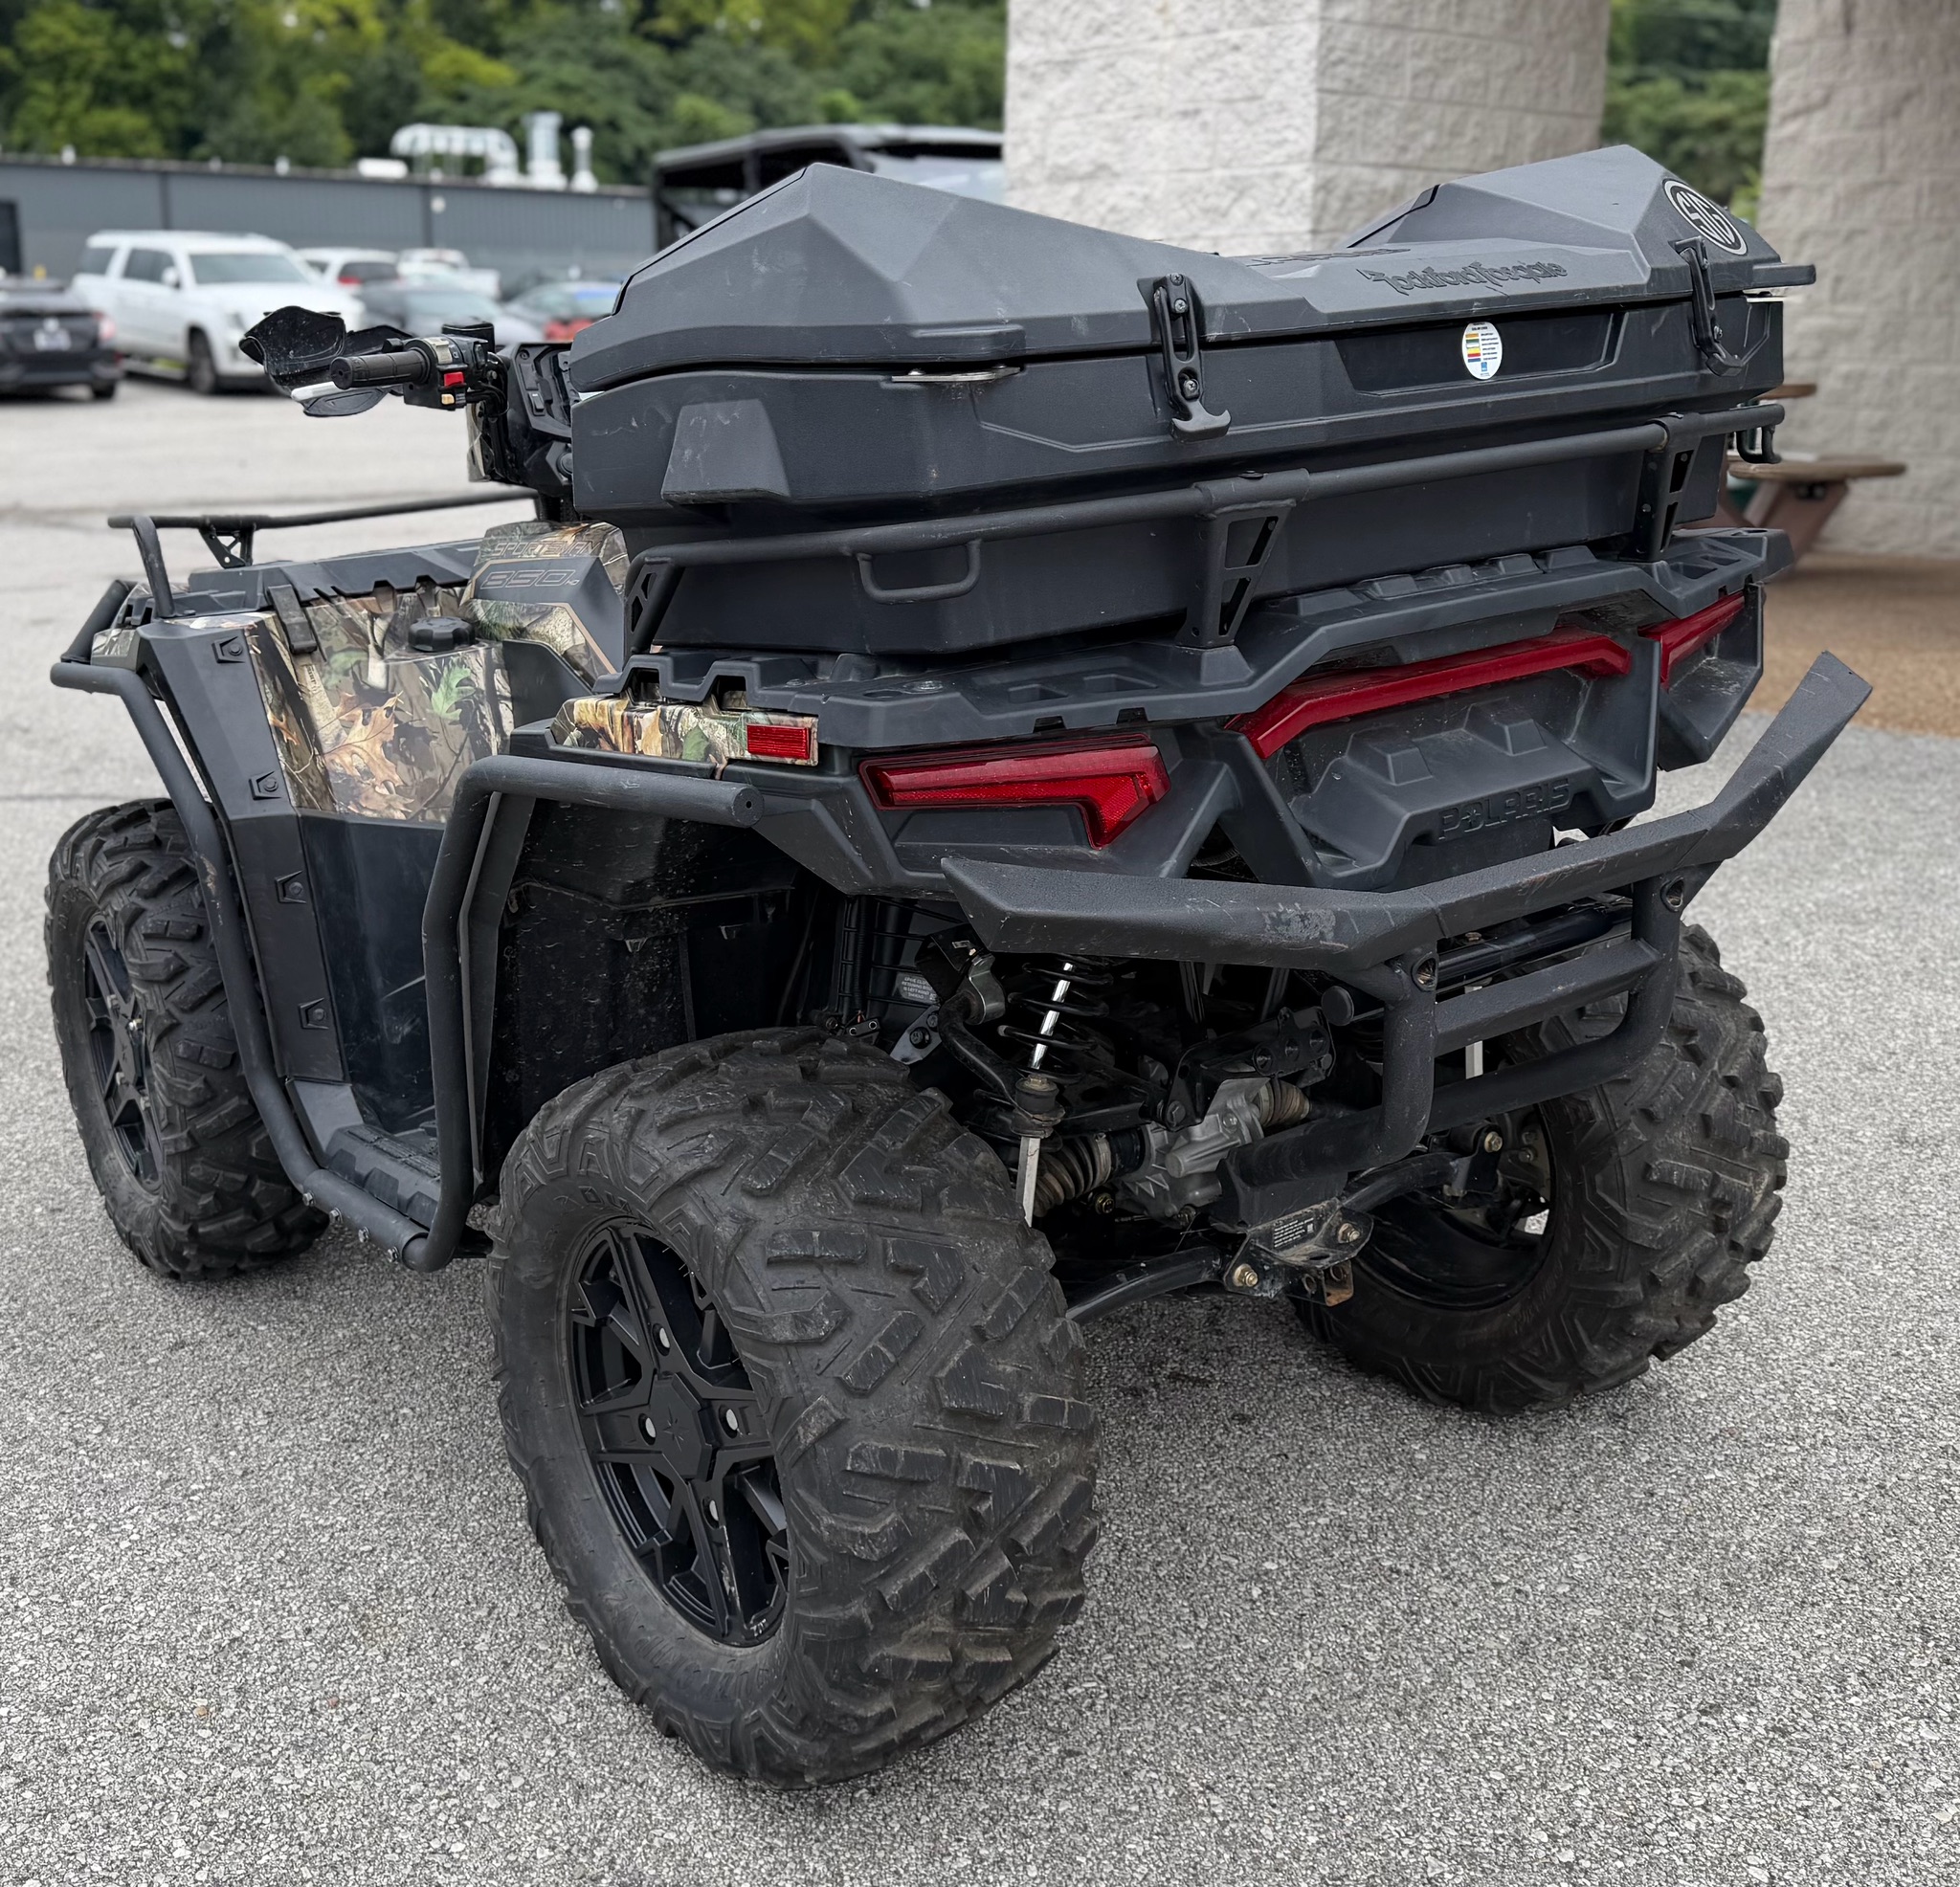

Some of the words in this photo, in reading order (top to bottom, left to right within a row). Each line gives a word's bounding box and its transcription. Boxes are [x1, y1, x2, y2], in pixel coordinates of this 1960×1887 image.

[492, 541, 602, 558] SPORTSMAN
[480, 569, 576, 589] 850
[1438, 778, 1571, 840] POLARIS
